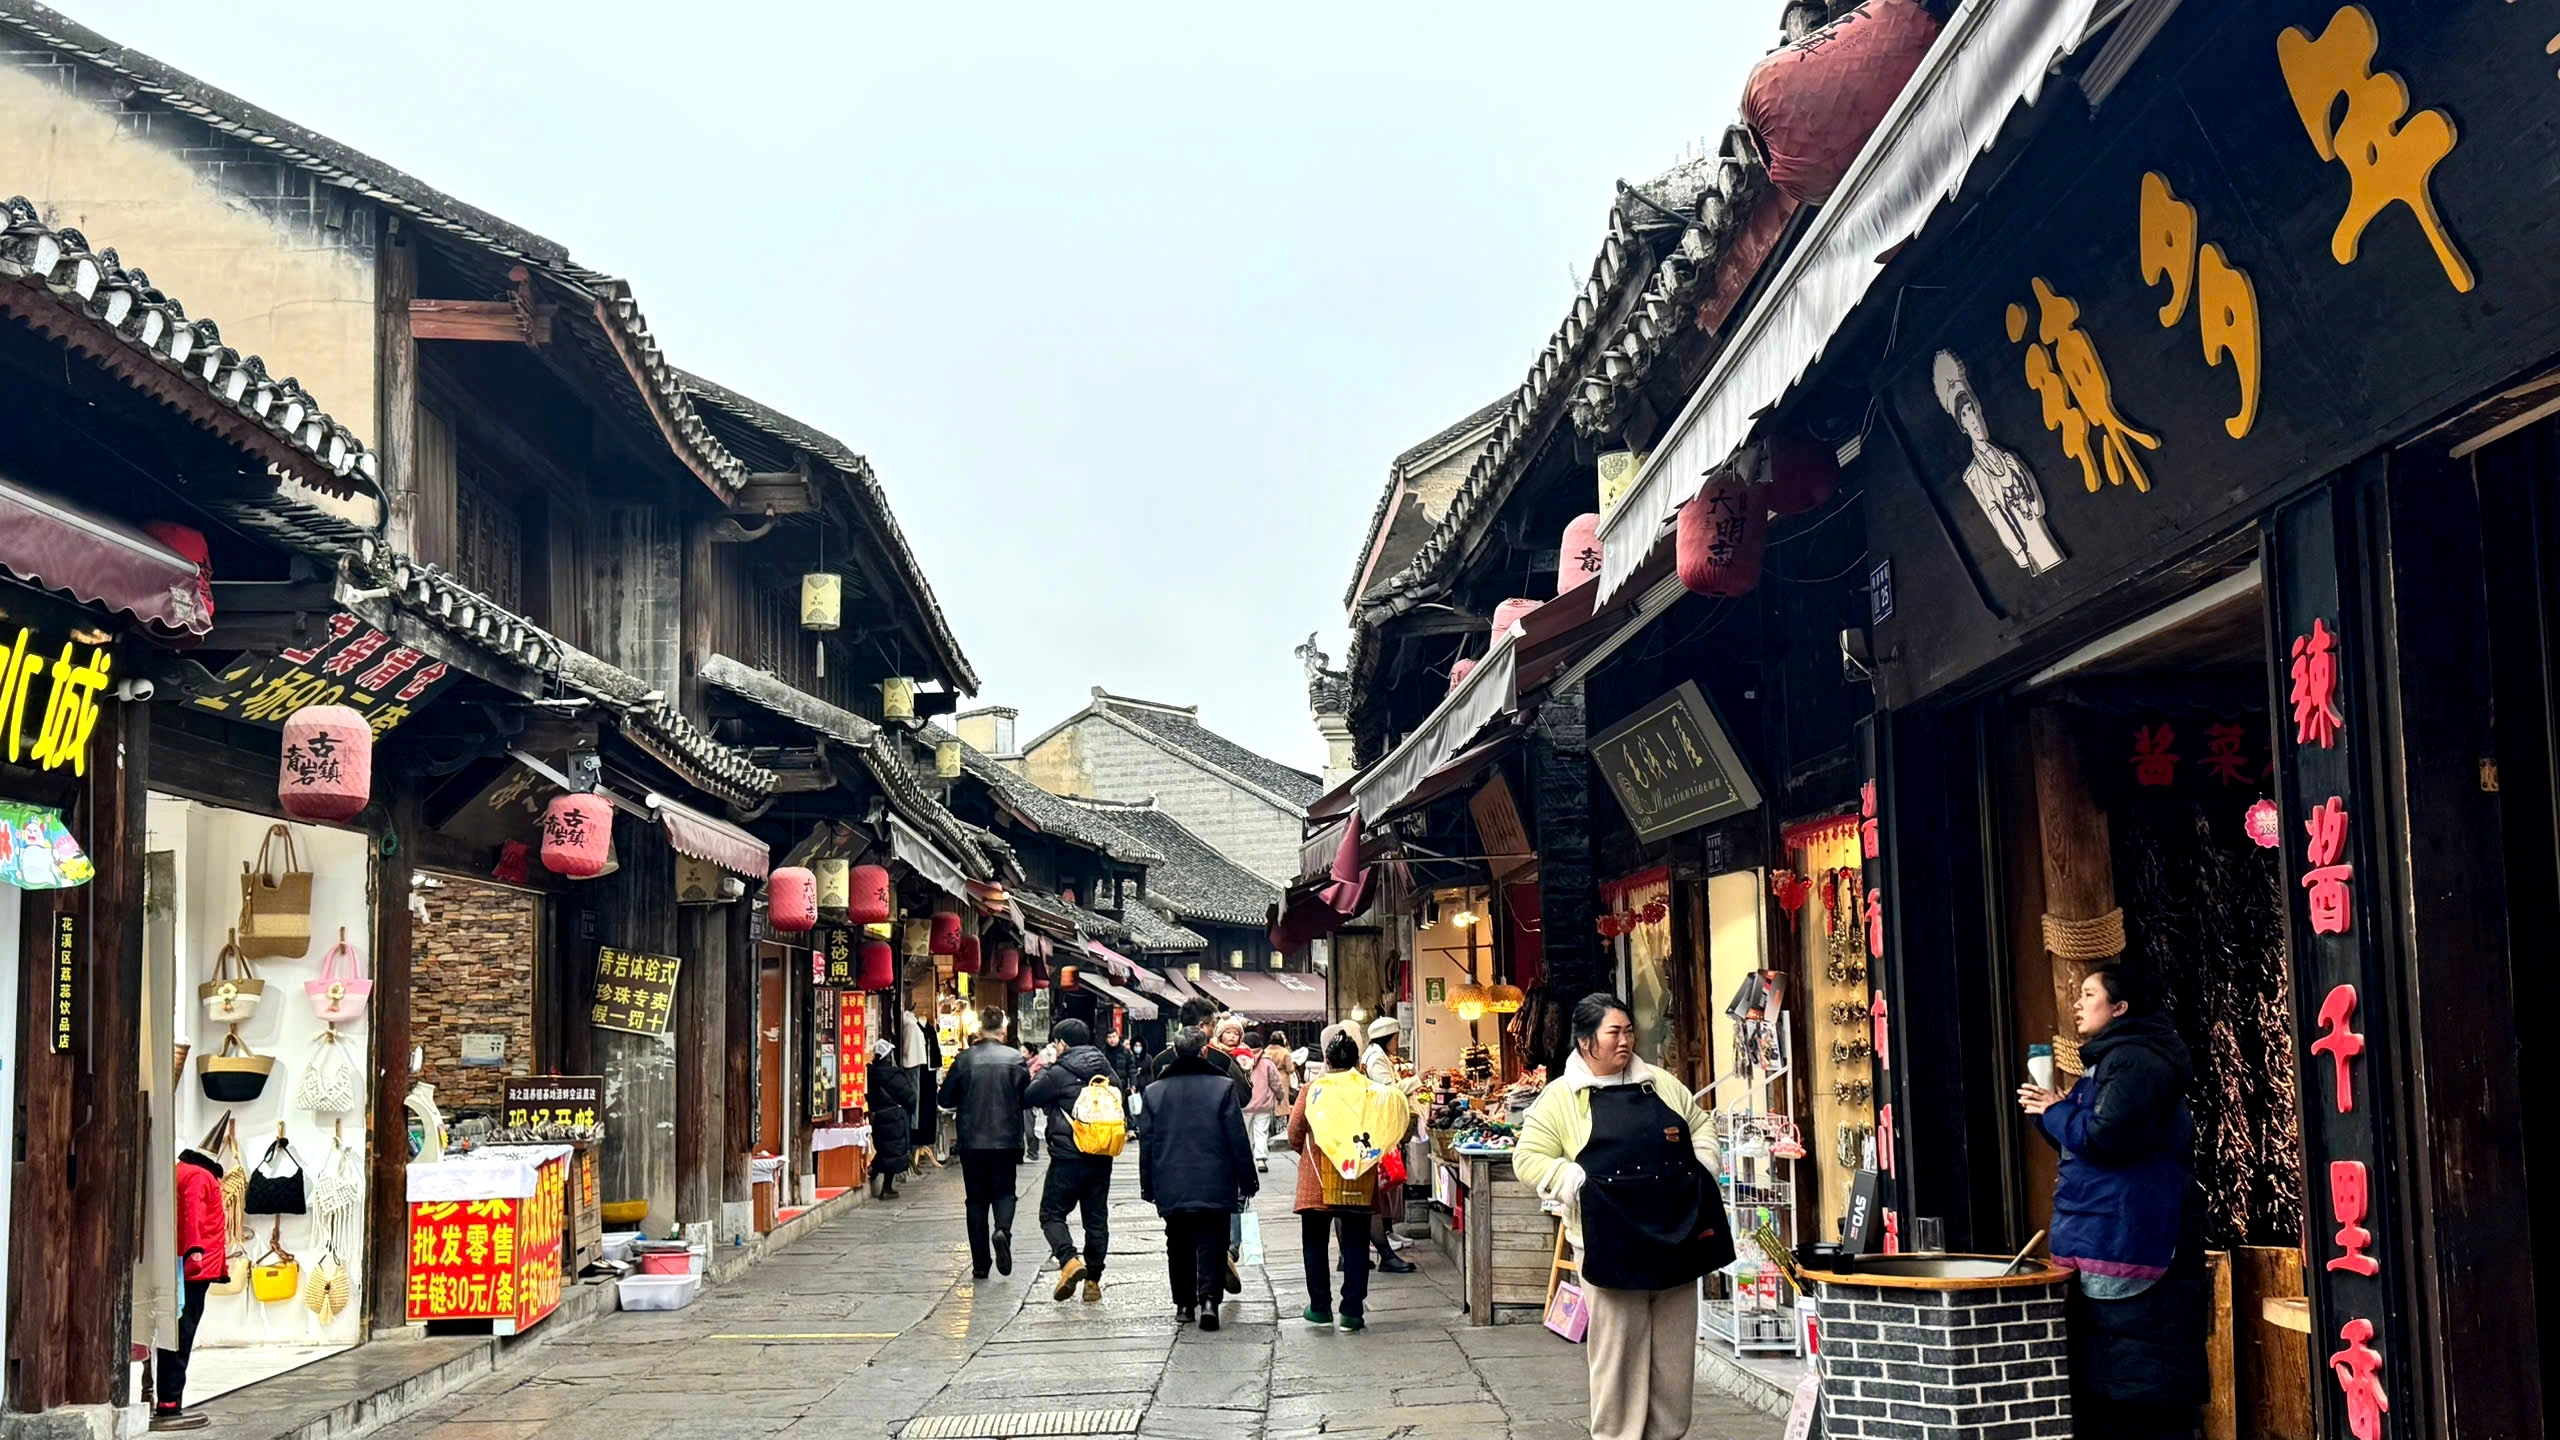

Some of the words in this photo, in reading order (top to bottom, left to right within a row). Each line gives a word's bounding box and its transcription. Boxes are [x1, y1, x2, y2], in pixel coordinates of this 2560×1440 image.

[2006, 4, 2560, 493] 辣多年
[2129, 722, 2273, 786] 酱菜
[601, 951, 676, 986] 青岩体验式
[831, 929, 849, 976] 朱砂阁
[591, 1003, 664, 1032] 假一罚十
[595, 983, 669, 1011] 珍珠专卖
[414, 1225, 515, 1266] 批发零售
[409, 1271, 515, 1314] 手链30元/条
